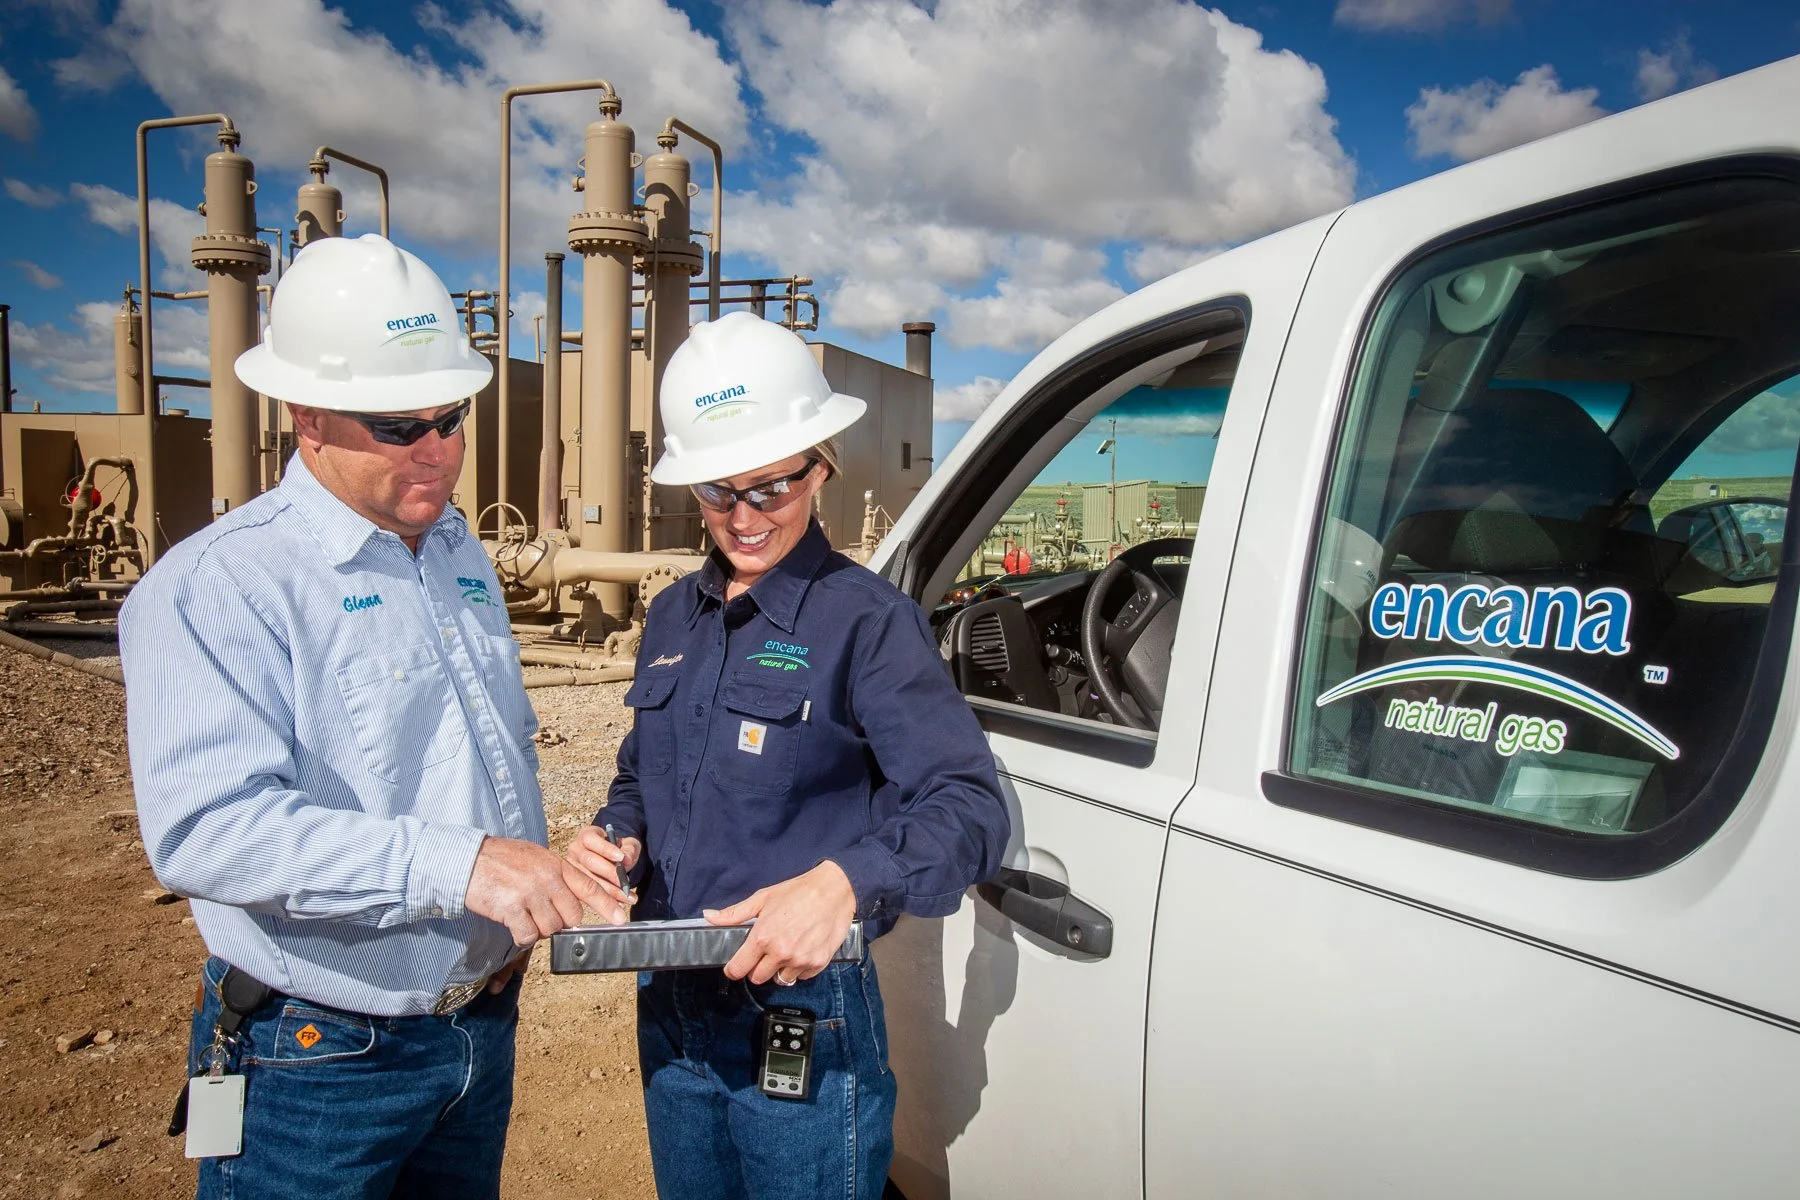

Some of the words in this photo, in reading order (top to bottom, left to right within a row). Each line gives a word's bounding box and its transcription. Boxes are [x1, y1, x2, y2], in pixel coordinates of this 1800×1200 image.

[387, 312, 436, 331] encana
[695, 384, 746, 408] encana
[343, 594, 383, 612] Glenn
[1371, 583, 1630, 655] encana
[764, 640, 809, 655] encana
[759, 659, 784, 668] natural
[784, 663, 798, 671] gas
[1386, 698, 1497, 742] natural
[1497, 715, 1566, 756] gas
[301, 1031, 317, 1041] FR
